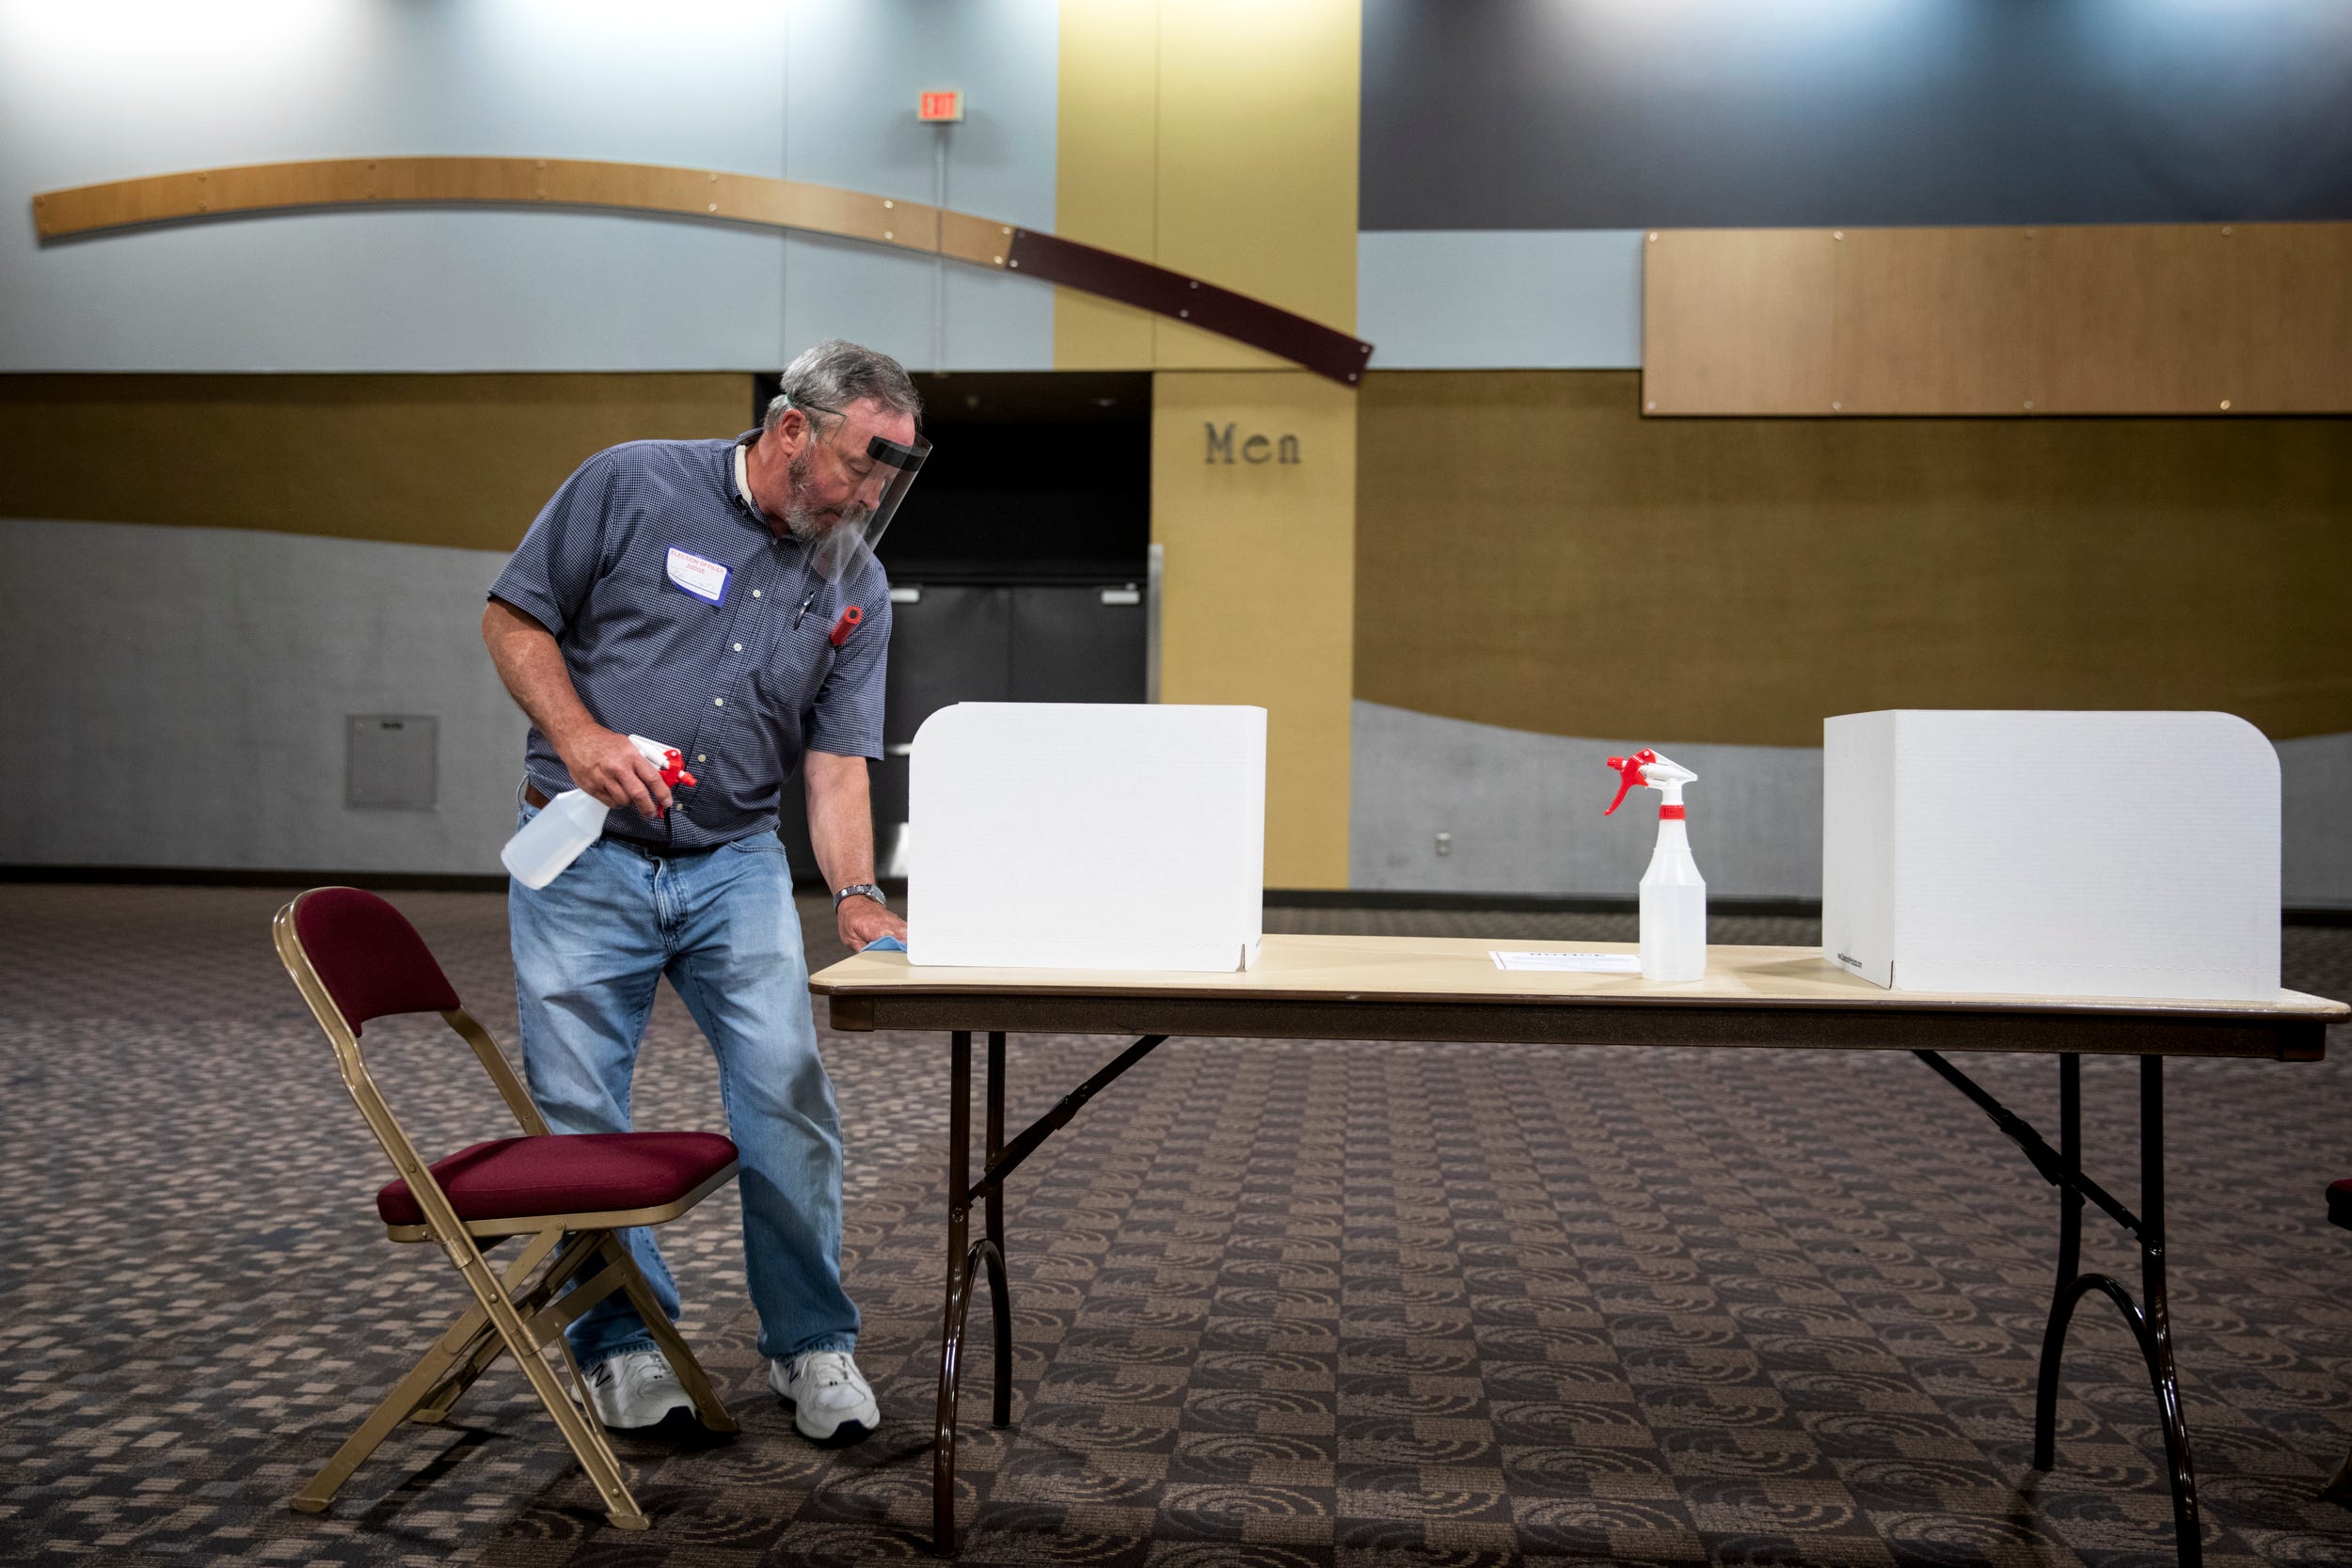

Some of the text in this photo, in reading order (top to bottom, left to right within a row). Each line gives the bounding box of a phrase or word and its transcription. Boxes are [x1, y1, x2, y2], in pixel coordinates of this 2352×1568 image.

[921, 92, 956, 119] EXIT
[1204, 421, 1301, 466] Men
[670, 549, 725, 574] ELECTION OFFICER
[685, 563, 707, 575] JUDGE
